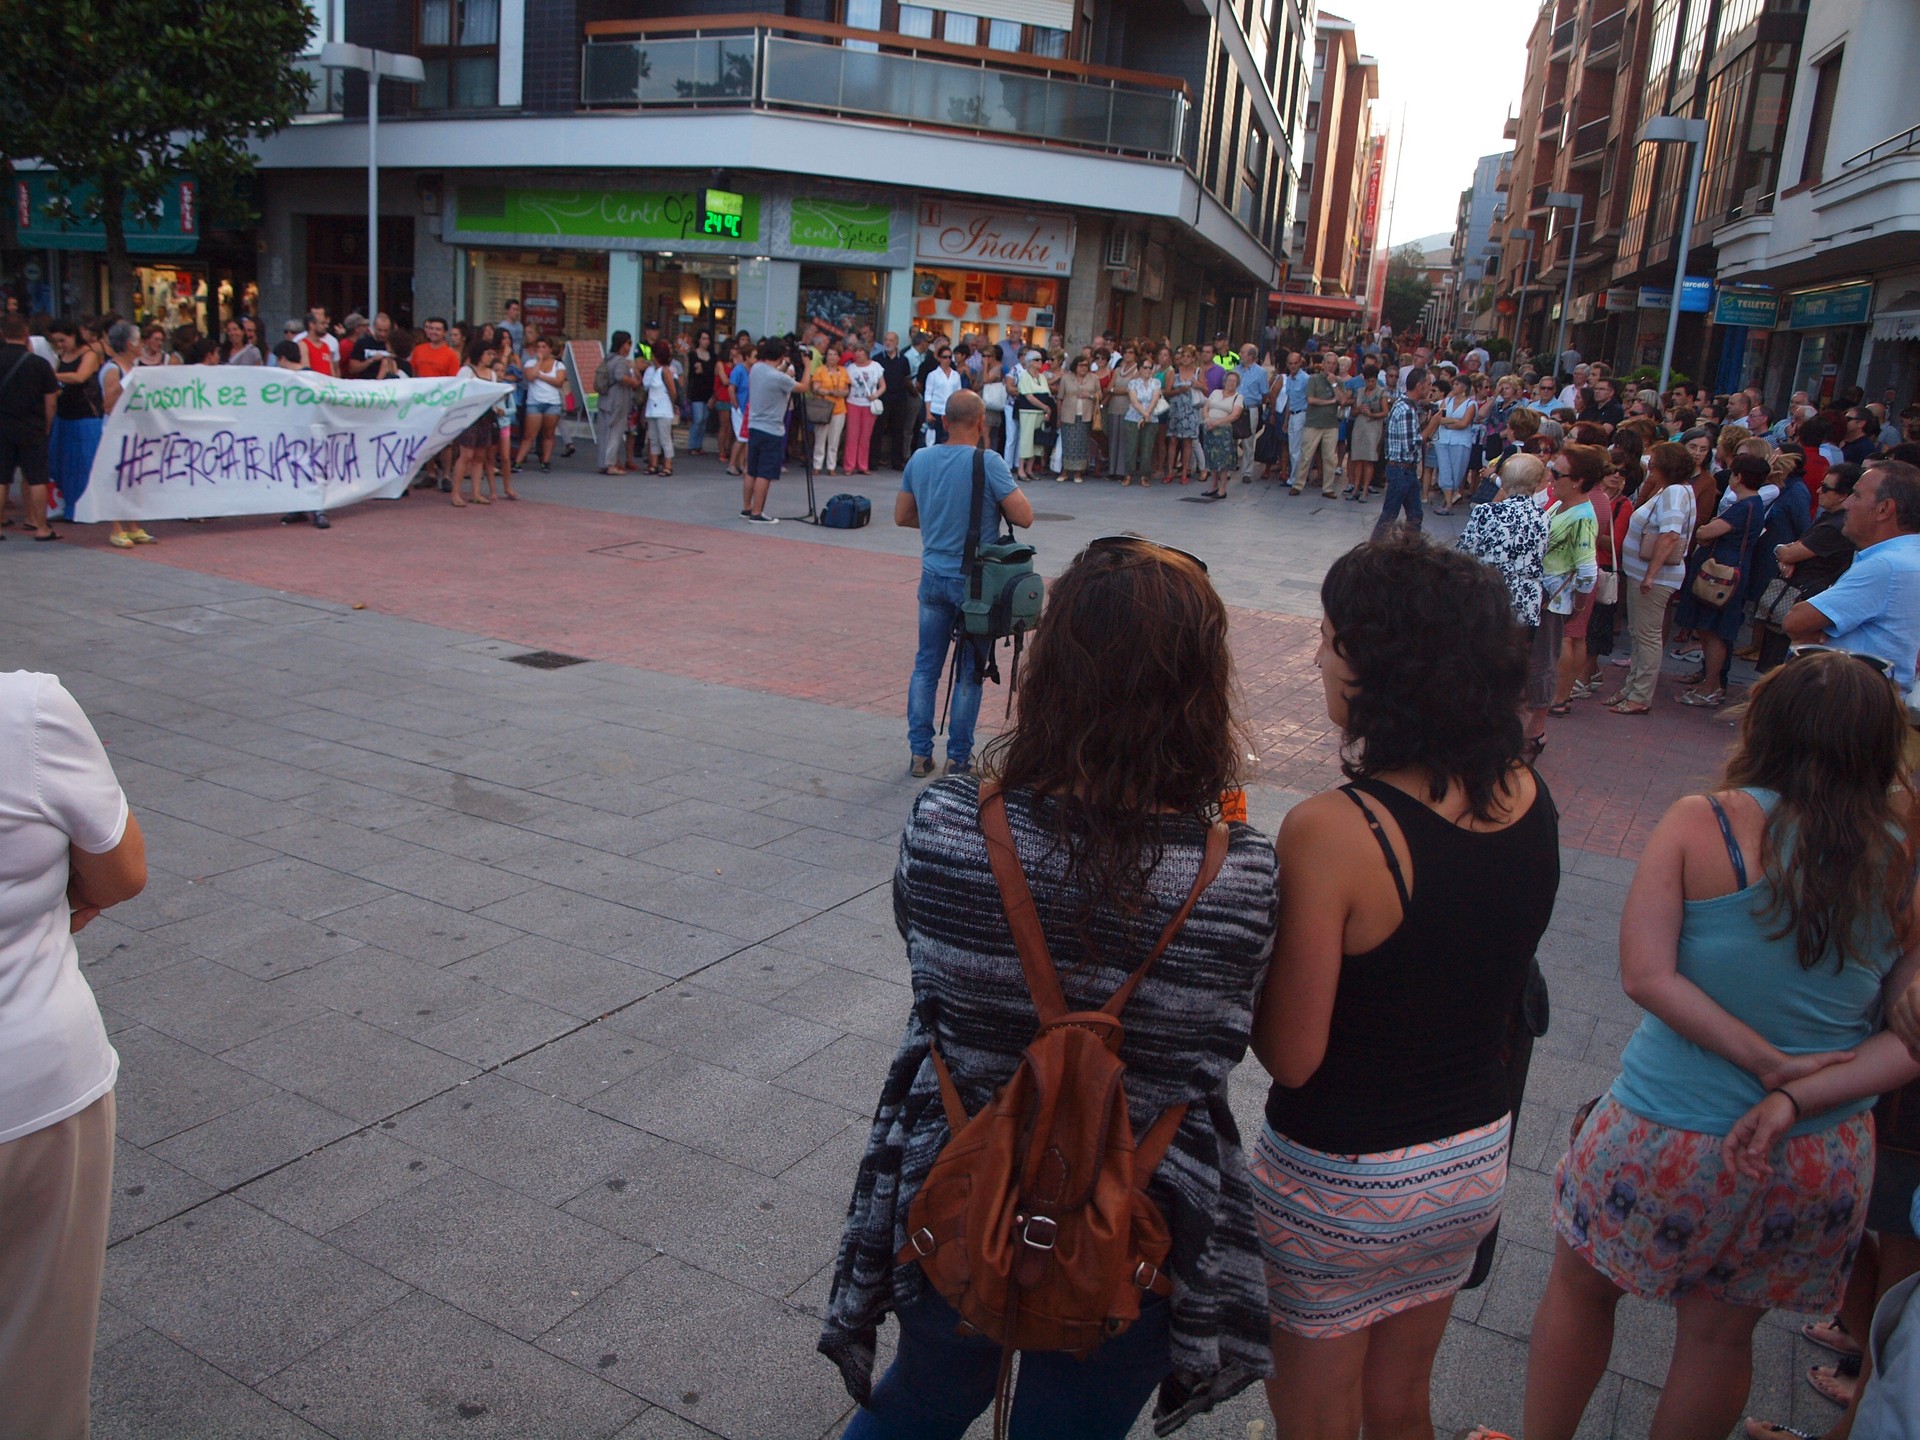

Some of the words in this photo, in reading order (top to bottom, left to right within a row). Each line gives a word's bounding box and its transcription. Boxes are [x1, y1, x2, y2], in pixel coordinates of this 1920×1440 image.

[600, 193, 694, 239] CentrÓp
[939, 215, 1056, 263] Iñaki
[126, 377, 212, 411] Erasorik
[217, 385, 248, 407] ez
